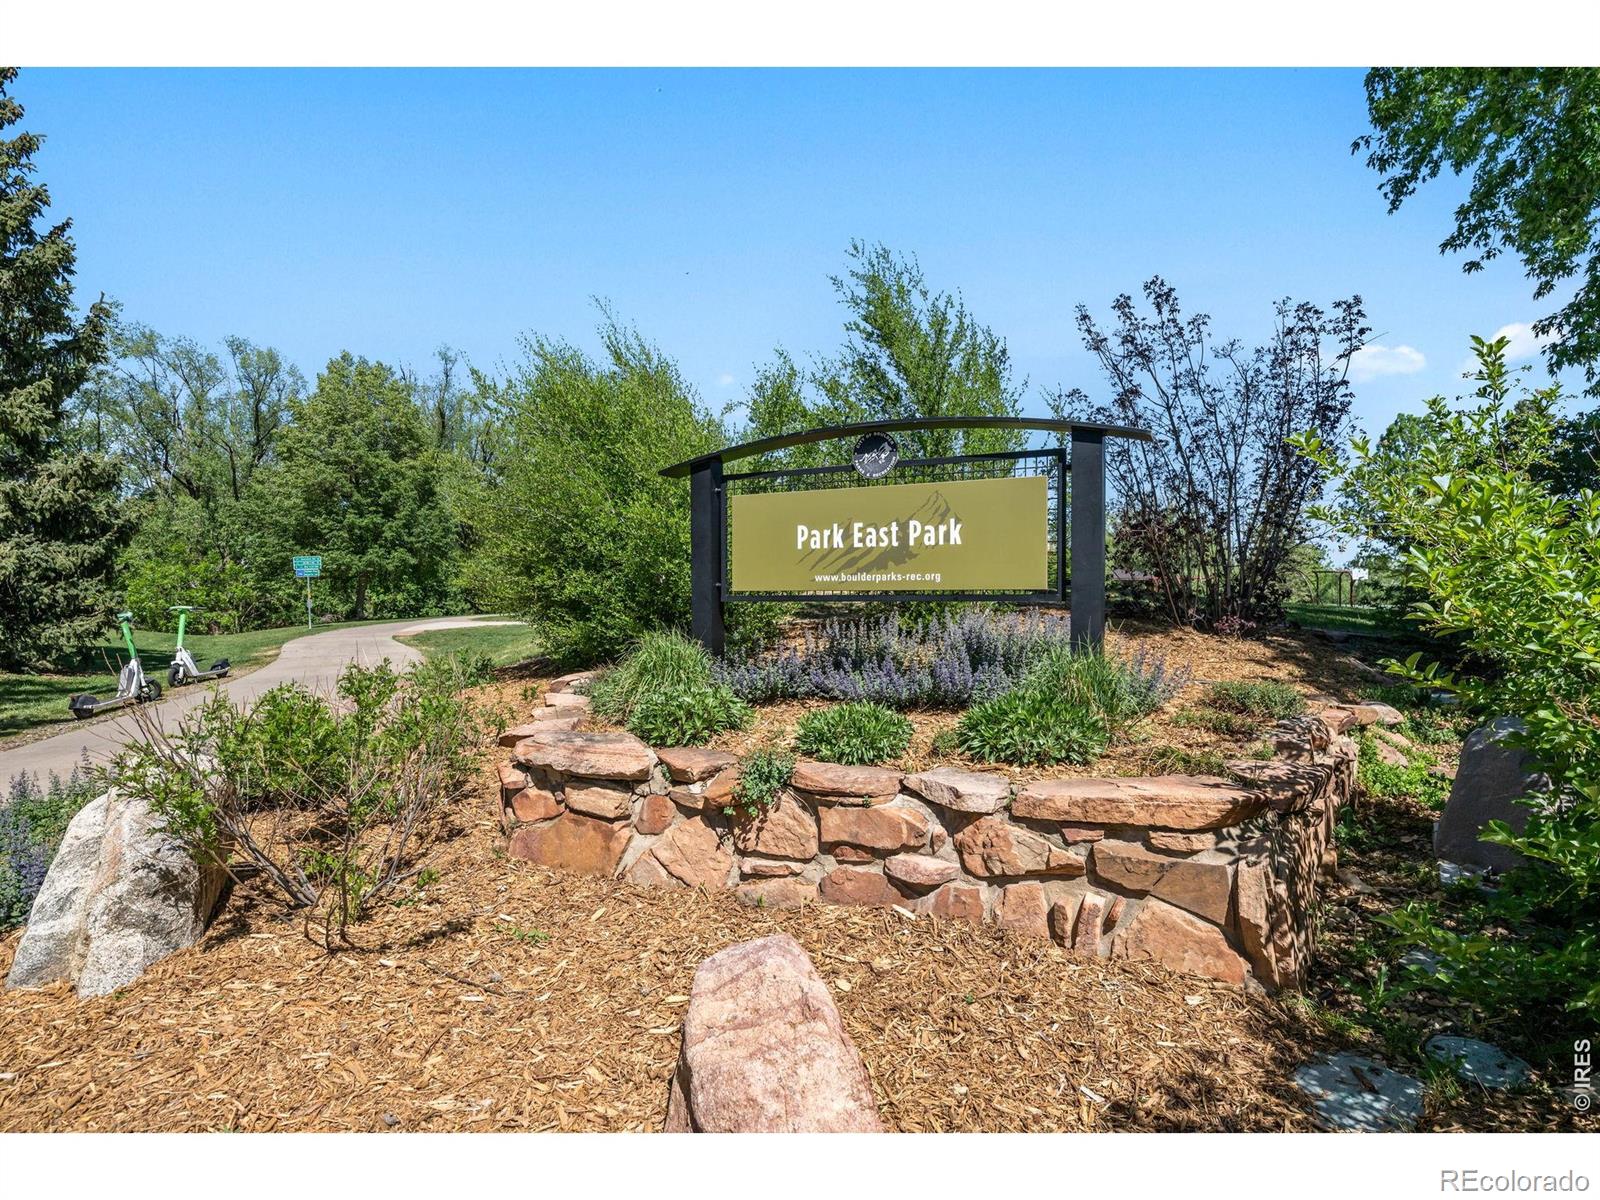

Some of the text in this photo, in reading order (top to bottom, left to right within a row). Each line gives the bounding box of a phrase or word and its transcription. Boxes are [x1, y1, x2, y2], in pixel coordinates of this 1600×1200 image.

[796, 518, 963, 550] Park East Park
[814, 571, 942, 583] www.boulderparks-rec.org
